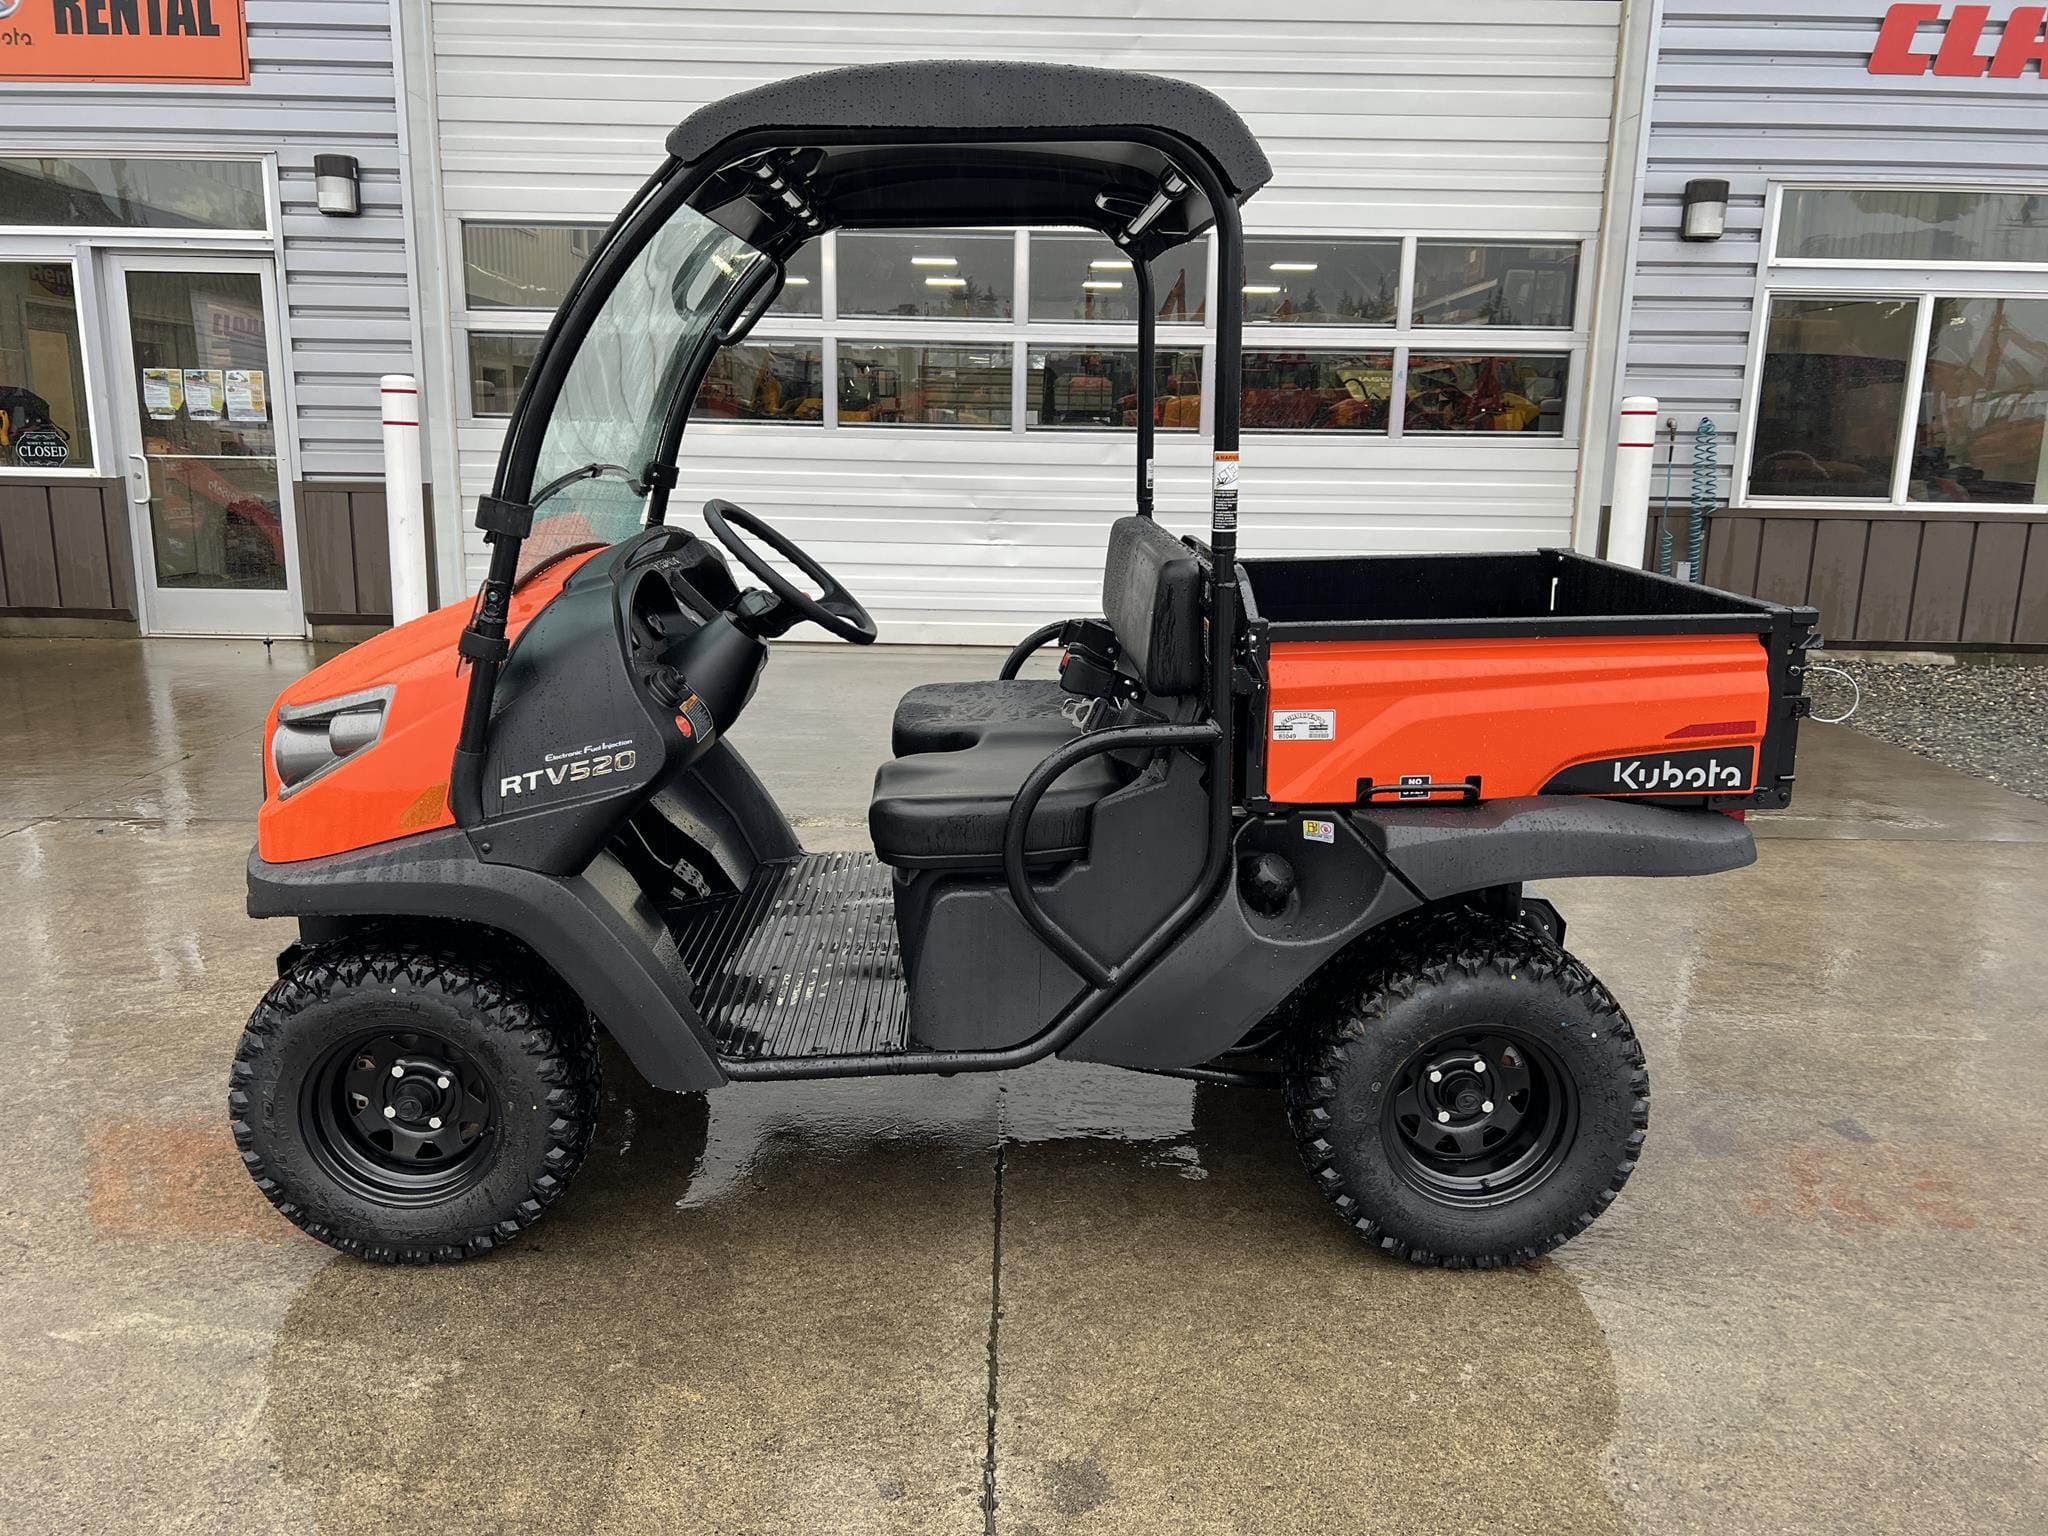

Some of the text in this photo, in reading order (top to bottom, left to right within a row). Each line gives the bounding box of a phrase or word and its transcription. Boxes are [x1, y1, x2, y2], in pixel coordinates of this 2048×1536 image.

[53, 0, 220, 36] RENTAL
[18, 445, 68, 458] CLOSED
[545, 739, 632, 762] Electronic Fuel Injection
[500, 750, 636, 797] RTV520
[1613, 759, 1741, 789] Kubota
